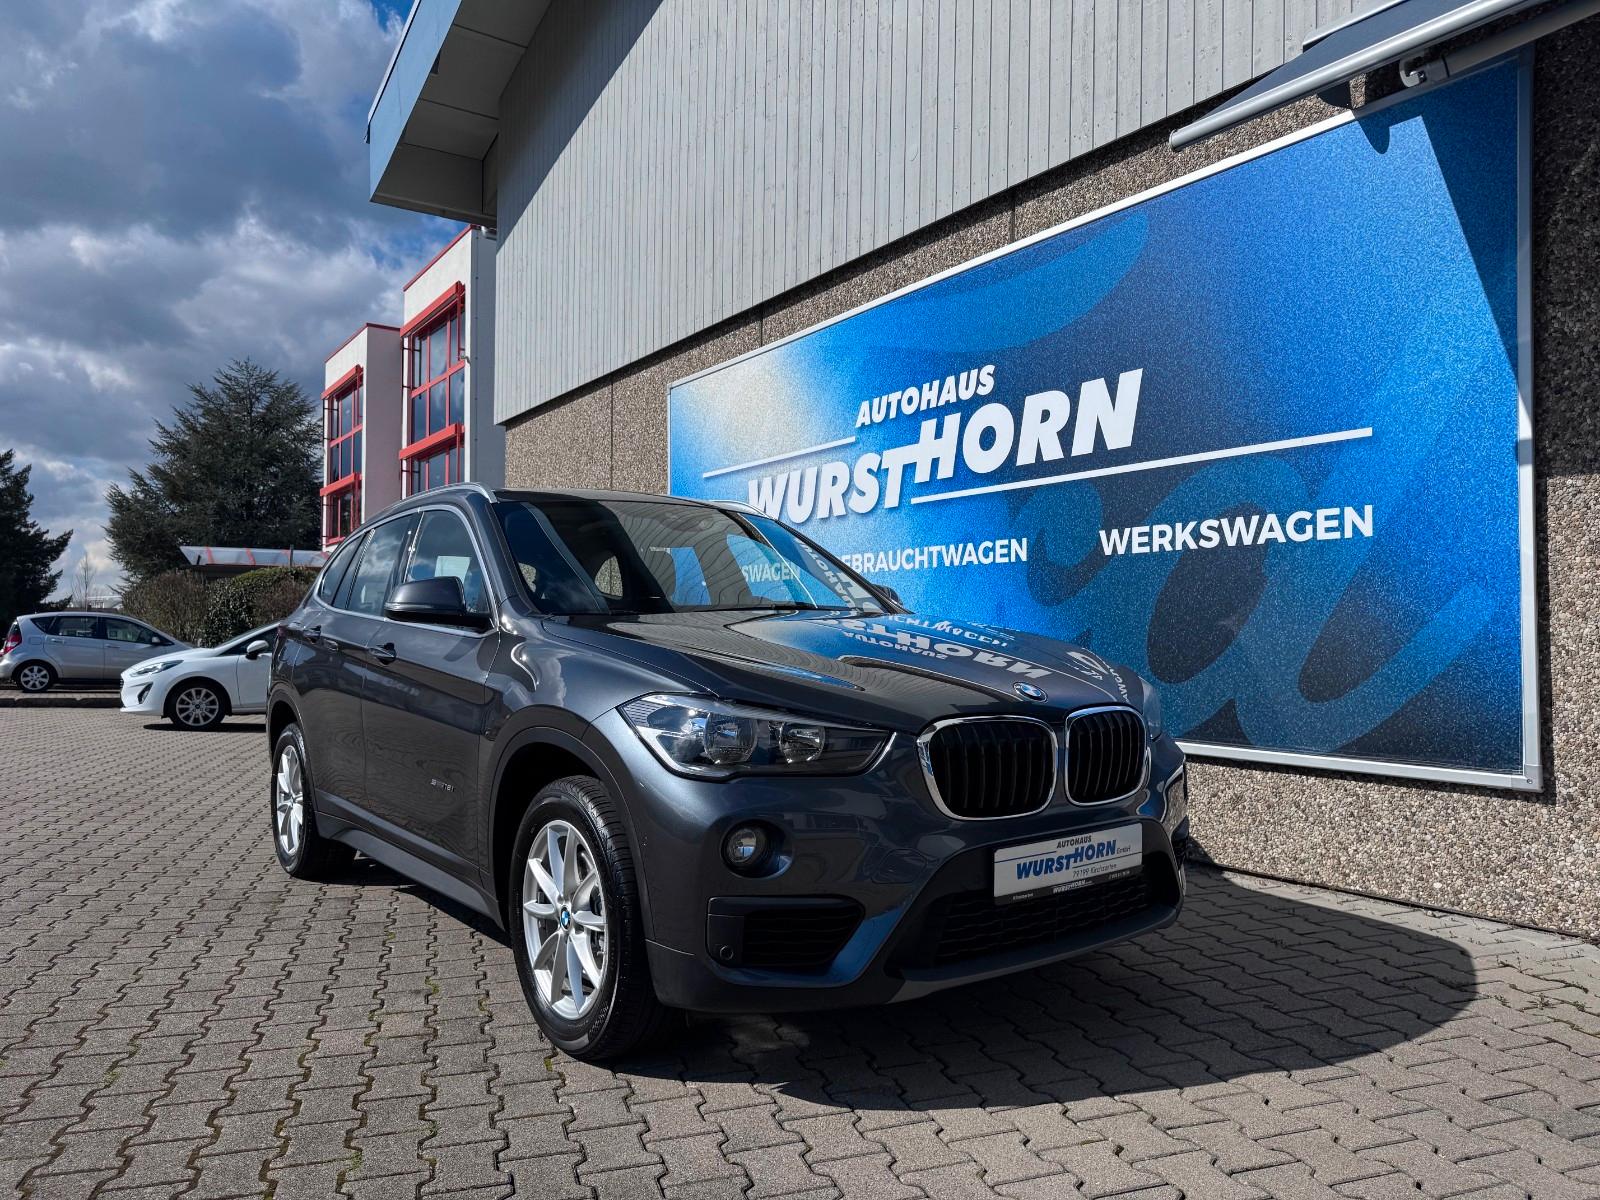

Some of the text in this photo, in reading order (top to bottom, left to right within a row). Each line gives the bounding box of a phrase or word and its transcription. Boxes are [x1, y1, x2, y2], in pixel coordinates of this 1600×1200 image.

[856, 364, 995, 427] AUTOHAUS
[748, 368, 1143, 523] WURSTHORN
[1099, 504, 1373, 556] WERKSWAGEN
[842, 537, 1028, 573] EBRAUCHTWAGEN
[1016, 839, 1117, 880] WURSTHORN
[1057, 835, 1092, 848] AUTOHAUS
